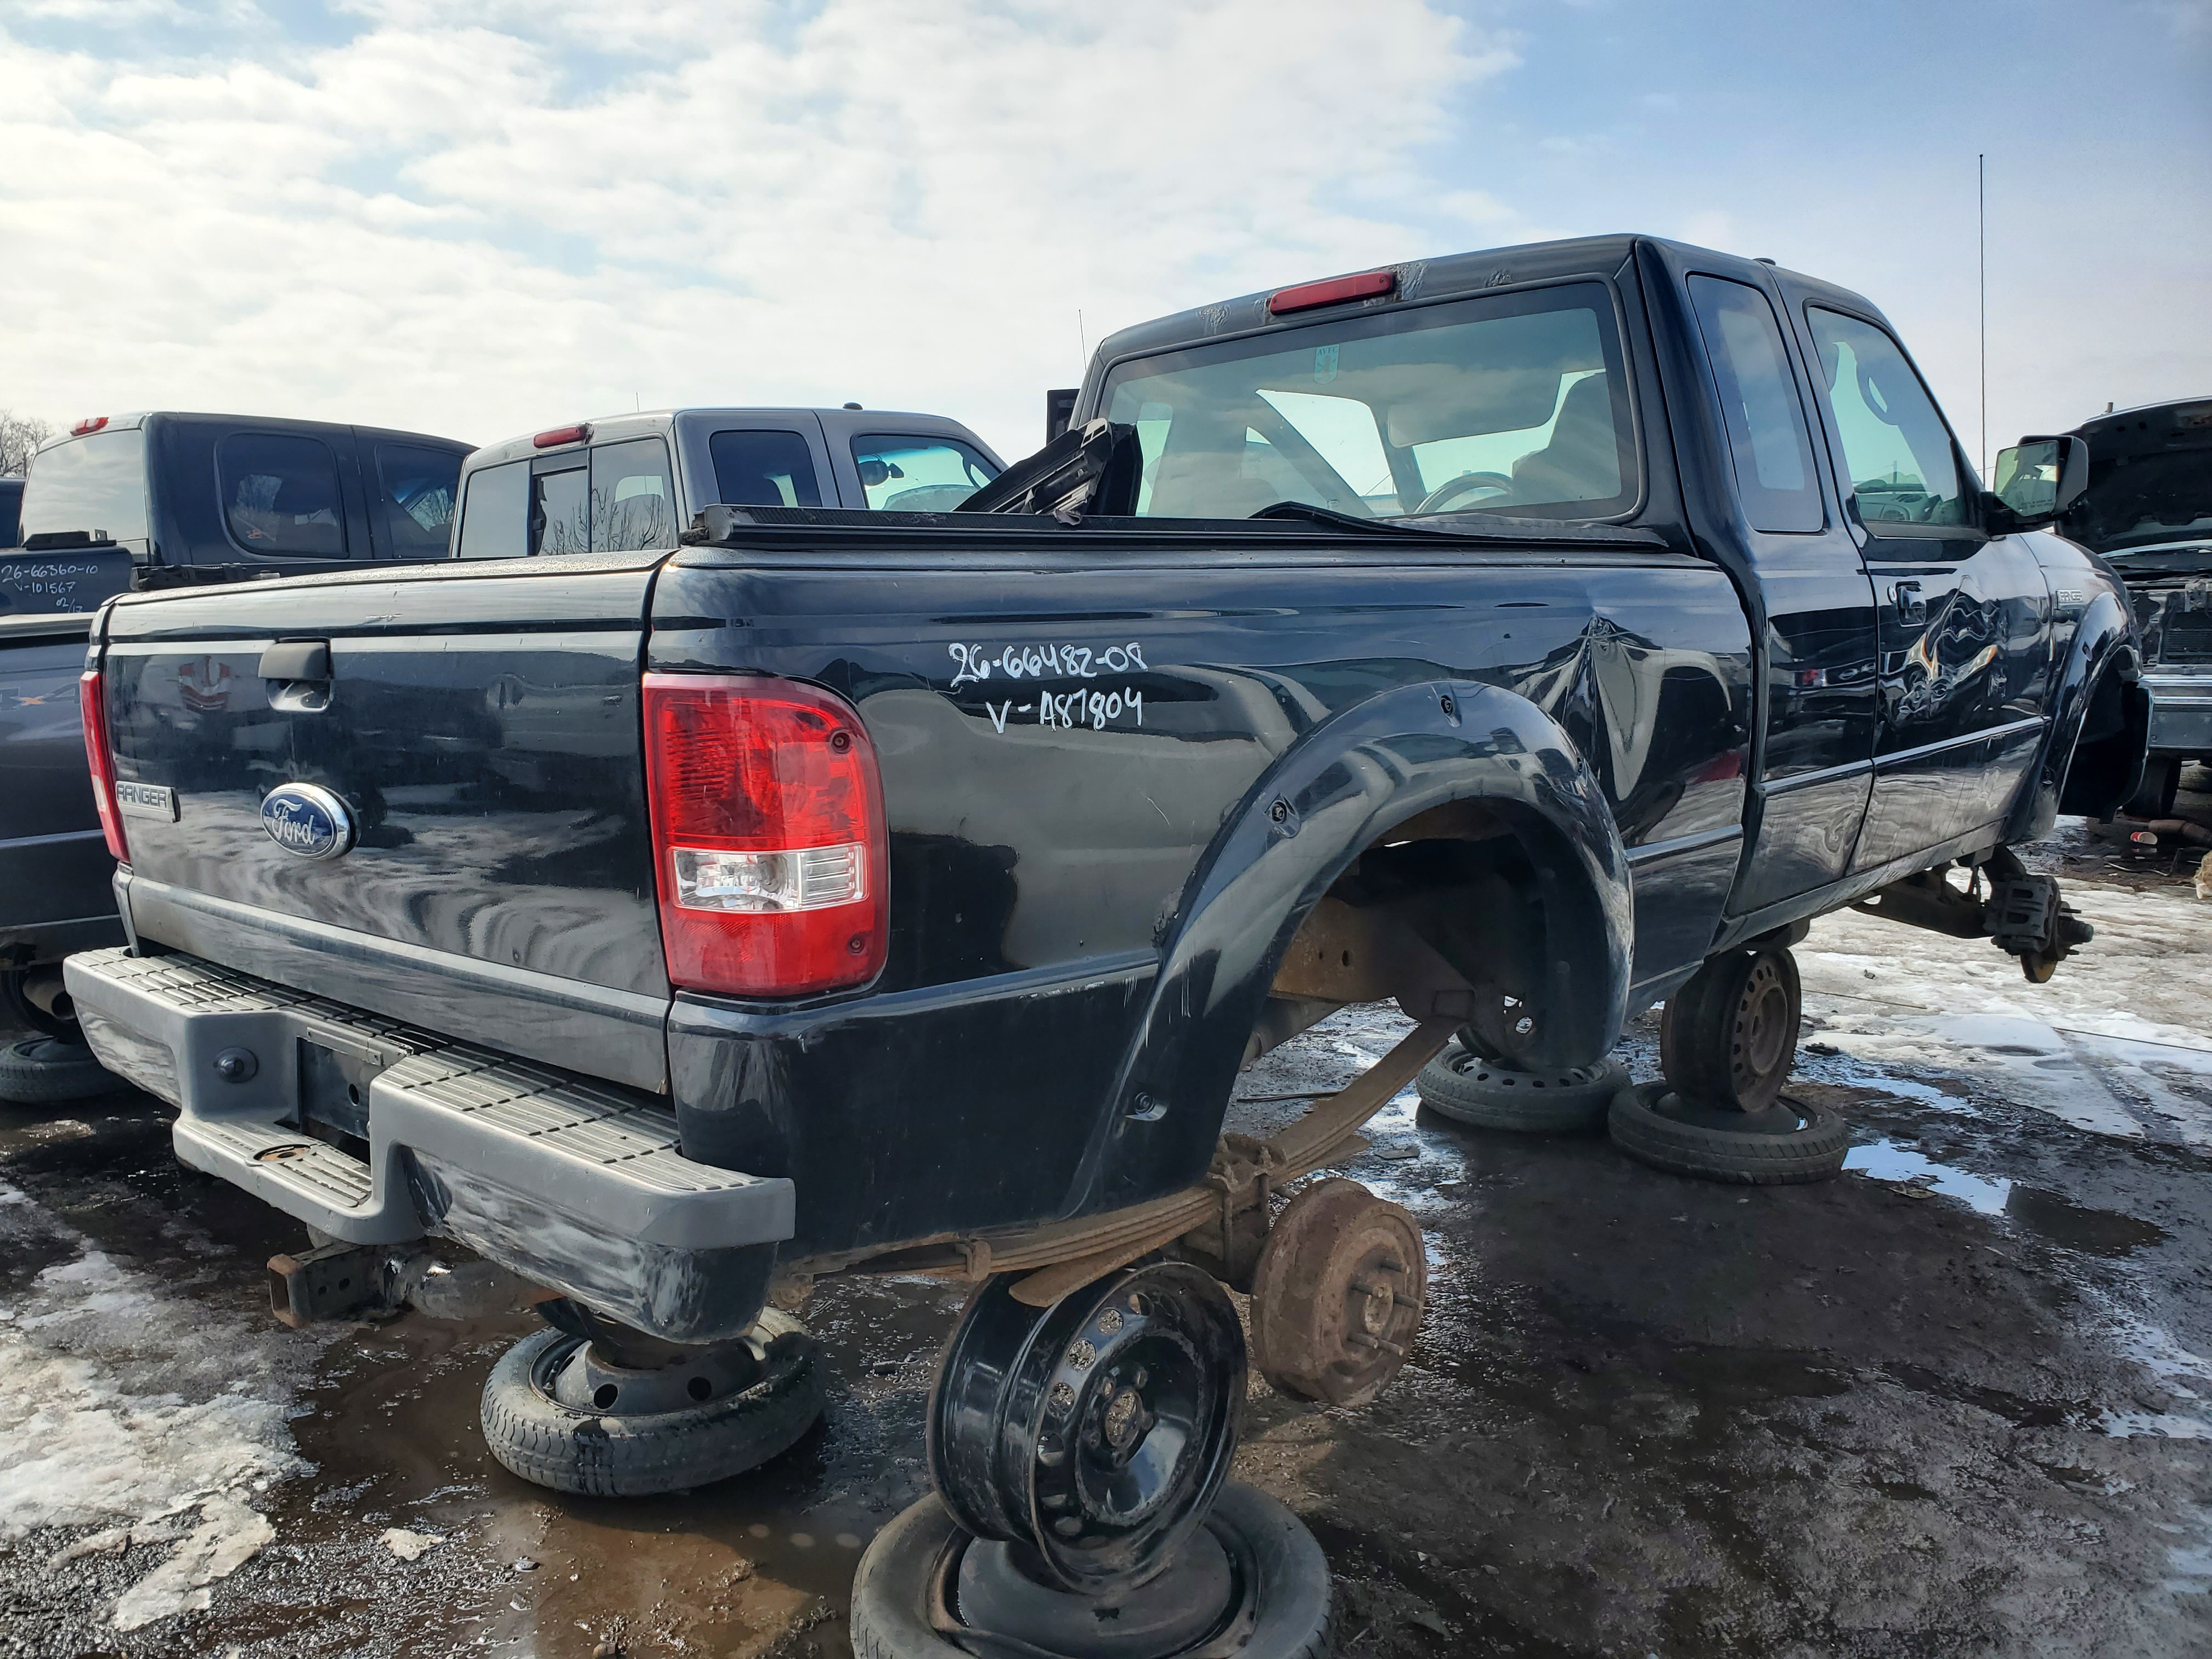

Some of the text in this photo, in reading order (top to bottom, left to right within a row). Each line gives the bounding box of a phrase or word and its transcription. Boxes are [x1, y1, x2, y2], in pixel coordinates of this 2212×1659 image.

[1318, 346, 1338, 356] AVFC
[1, 565, 98, 583] 26-66360-10
[116, 785, 167, 808] RANGER
[272, 799, 315, 845] Ford
